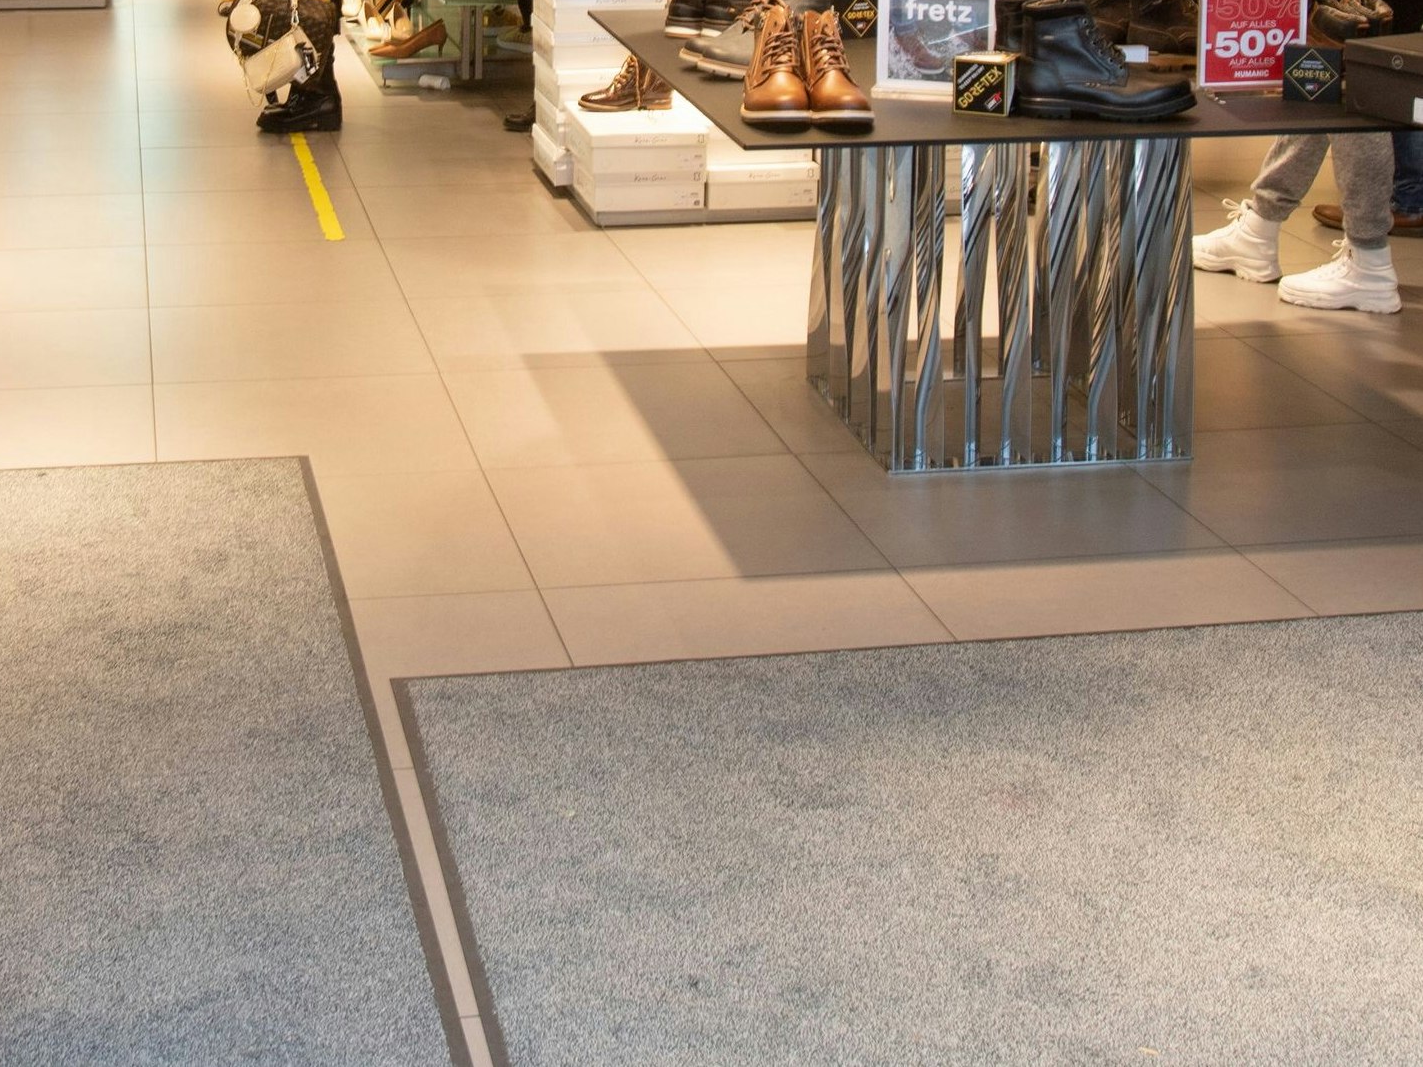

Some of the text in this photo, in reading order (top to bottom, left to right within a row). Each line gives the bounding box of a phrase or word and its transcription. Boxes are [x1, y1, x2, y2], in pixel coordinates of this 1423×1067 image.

[1230, 19, 1277, 29] AUF ALLES
[1229, 58, 1247, 67] AUF
[1248, 56, 1275, 65] ALLES
[1234, 69, 1270, 79] HUMANIC
